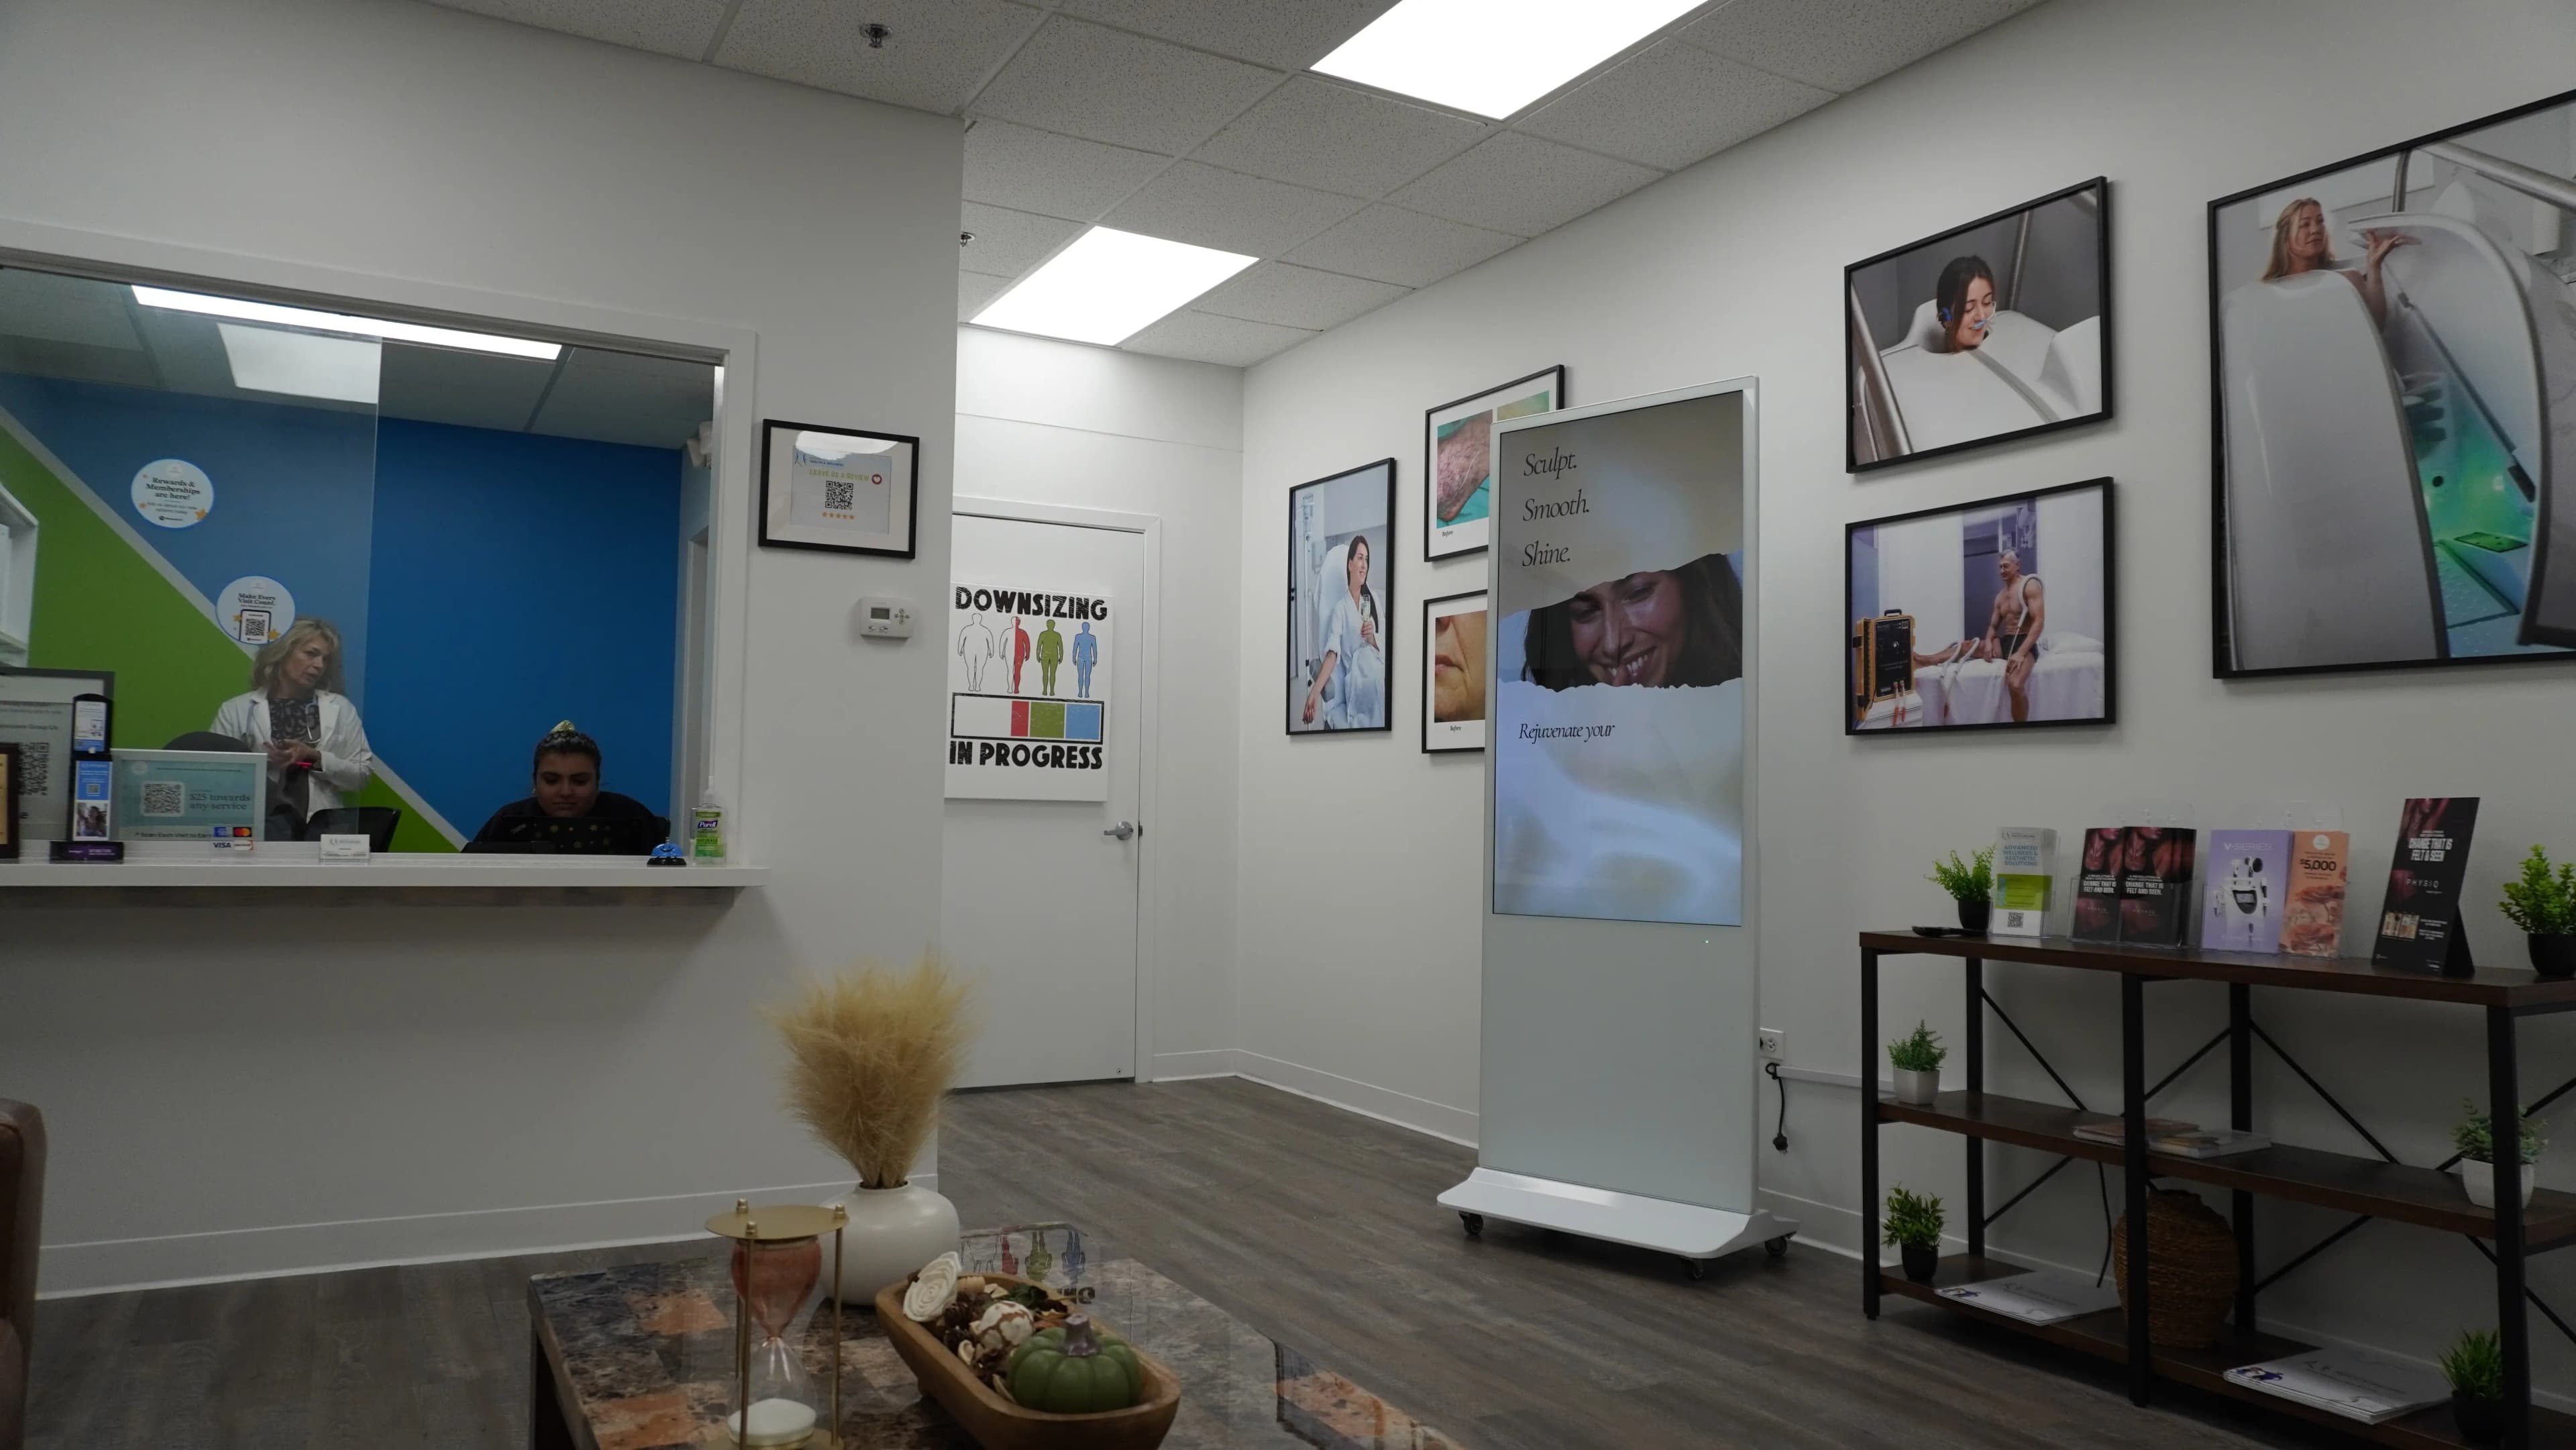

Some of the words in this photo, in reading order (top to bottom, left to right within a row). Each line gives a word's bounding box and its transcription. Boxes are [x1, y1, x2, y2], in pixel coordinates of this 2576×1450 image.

[1523, 446, 1577, 480] Sculpt.
[810, 468, 828, 477] LEAVE
[847, 472, 869, 481] REVIEW
[152, 477, 186, 487] Rewards
[146, 483, 201, 495] Memberships
[1523, 489, 1589, 522] Smooth.
[1521, 540, 1570, 568] Shine.
[955, 586, 1108, 621] DOWNSIZING
[1519, 723, 1583, 745] Rejuvenate
[1584, 725, 1615, 742] your
[949, 740, 973, 765] IN
[979, 742, 1102, 770] PROGRESS
[189, 793, 207, 801] $25
[2408, 838, 2430, 849] CHANGE
[2431, 838, 2446, 849] THAT
[2446, 839, 2453, 849] IS
[2300, 858, 2337, 871] $5,000
[2406, 878, 2440, 888] PHYSIQ
